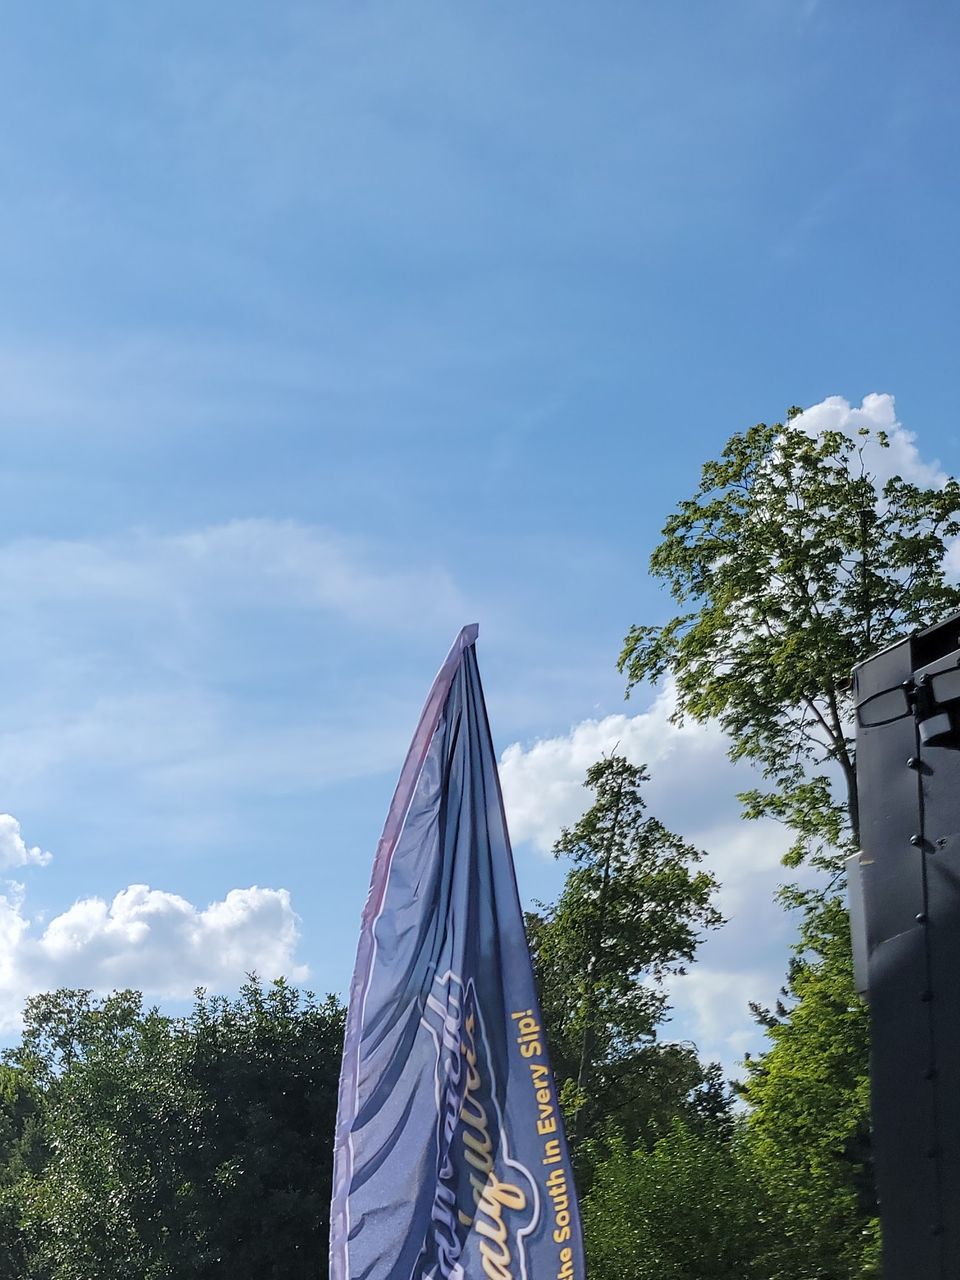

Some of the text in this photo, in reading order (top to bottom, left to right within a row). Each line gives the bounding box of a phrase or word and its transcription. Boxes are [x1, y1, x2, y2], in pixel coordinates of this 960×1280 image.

[511, 1008, 542, 1059] Sip!
[529, 1064, 558, 1135] Every
[542, 1139, 561, 1167] in
[546, 1169, 572, 1244] South
